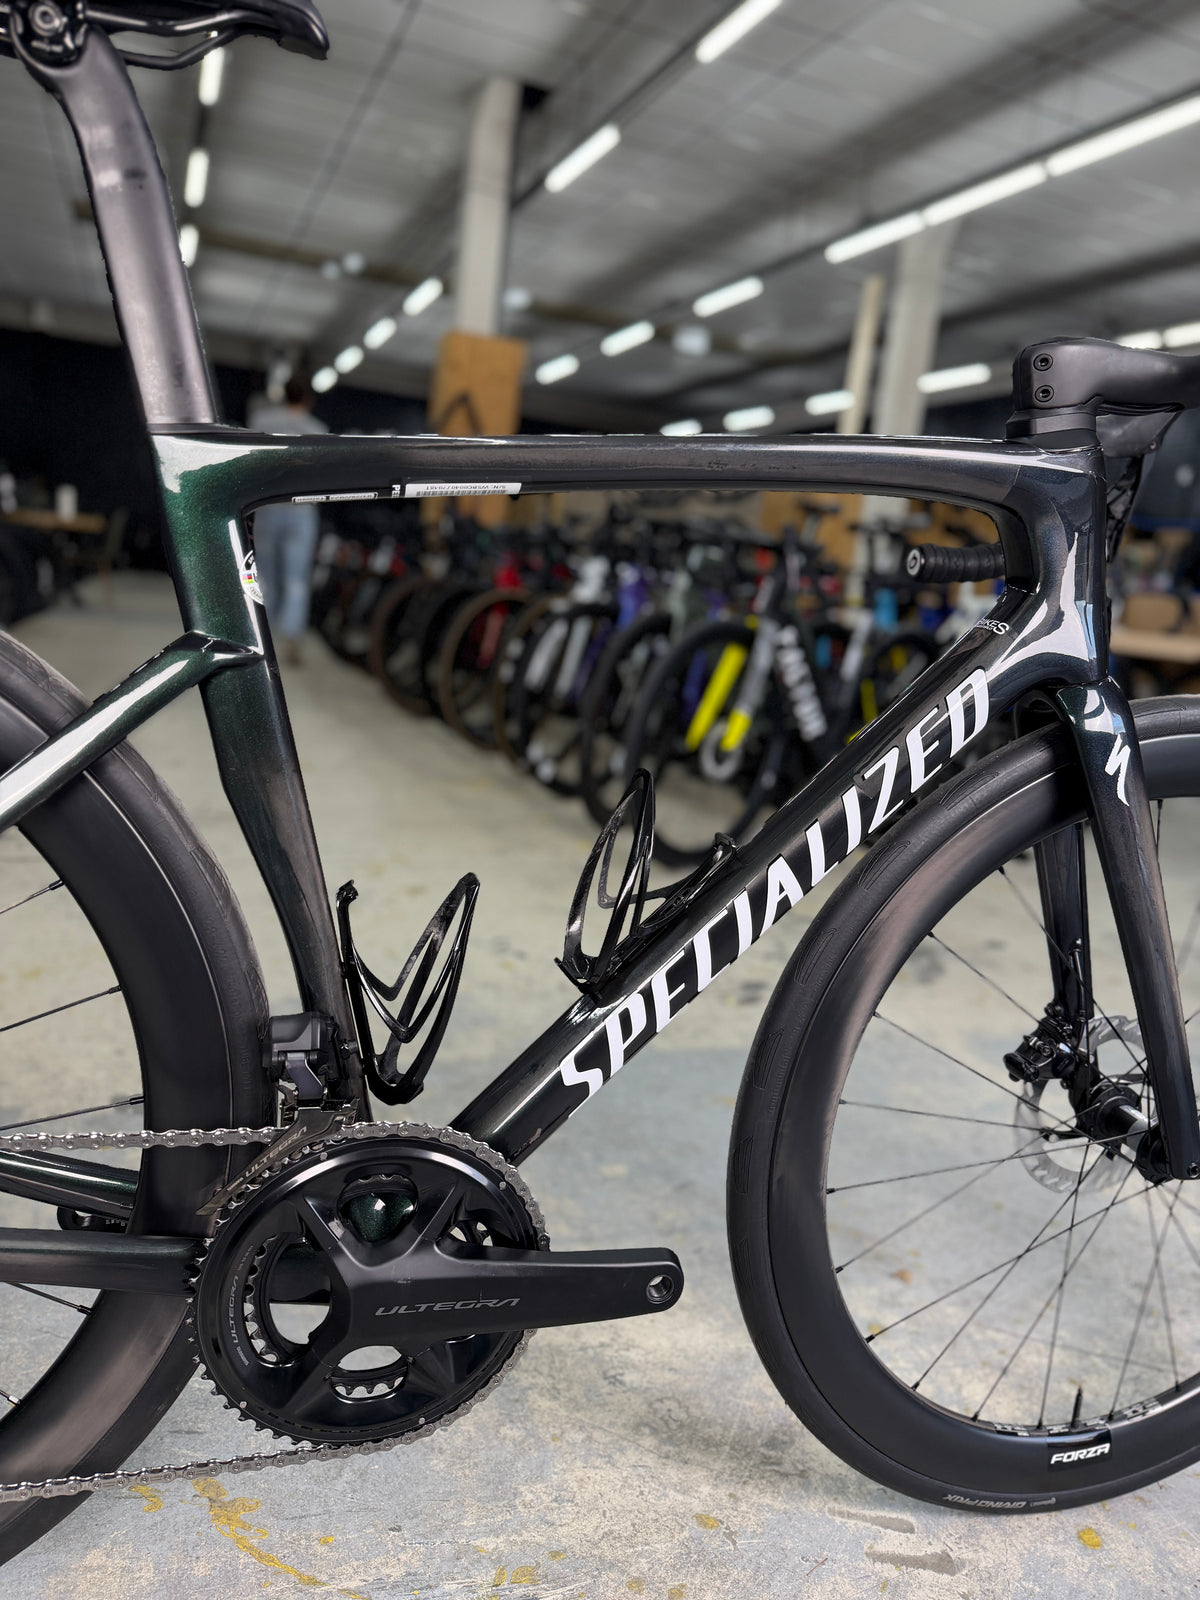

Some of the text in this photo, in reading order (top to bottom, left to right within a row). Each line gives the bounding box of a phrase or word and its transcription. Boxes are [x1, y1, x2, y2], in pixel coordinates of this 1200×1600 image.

[559, 668, 989, 1097] SPECIALIZED
[245, 1126, 307, 1177] ULTEGRA
[228, 1275, 239, 1344] ULTEGRA
[375, 1298, 521, 1316] ULTEGRA
[1050, 1443, 1111, 1464] FORZA
